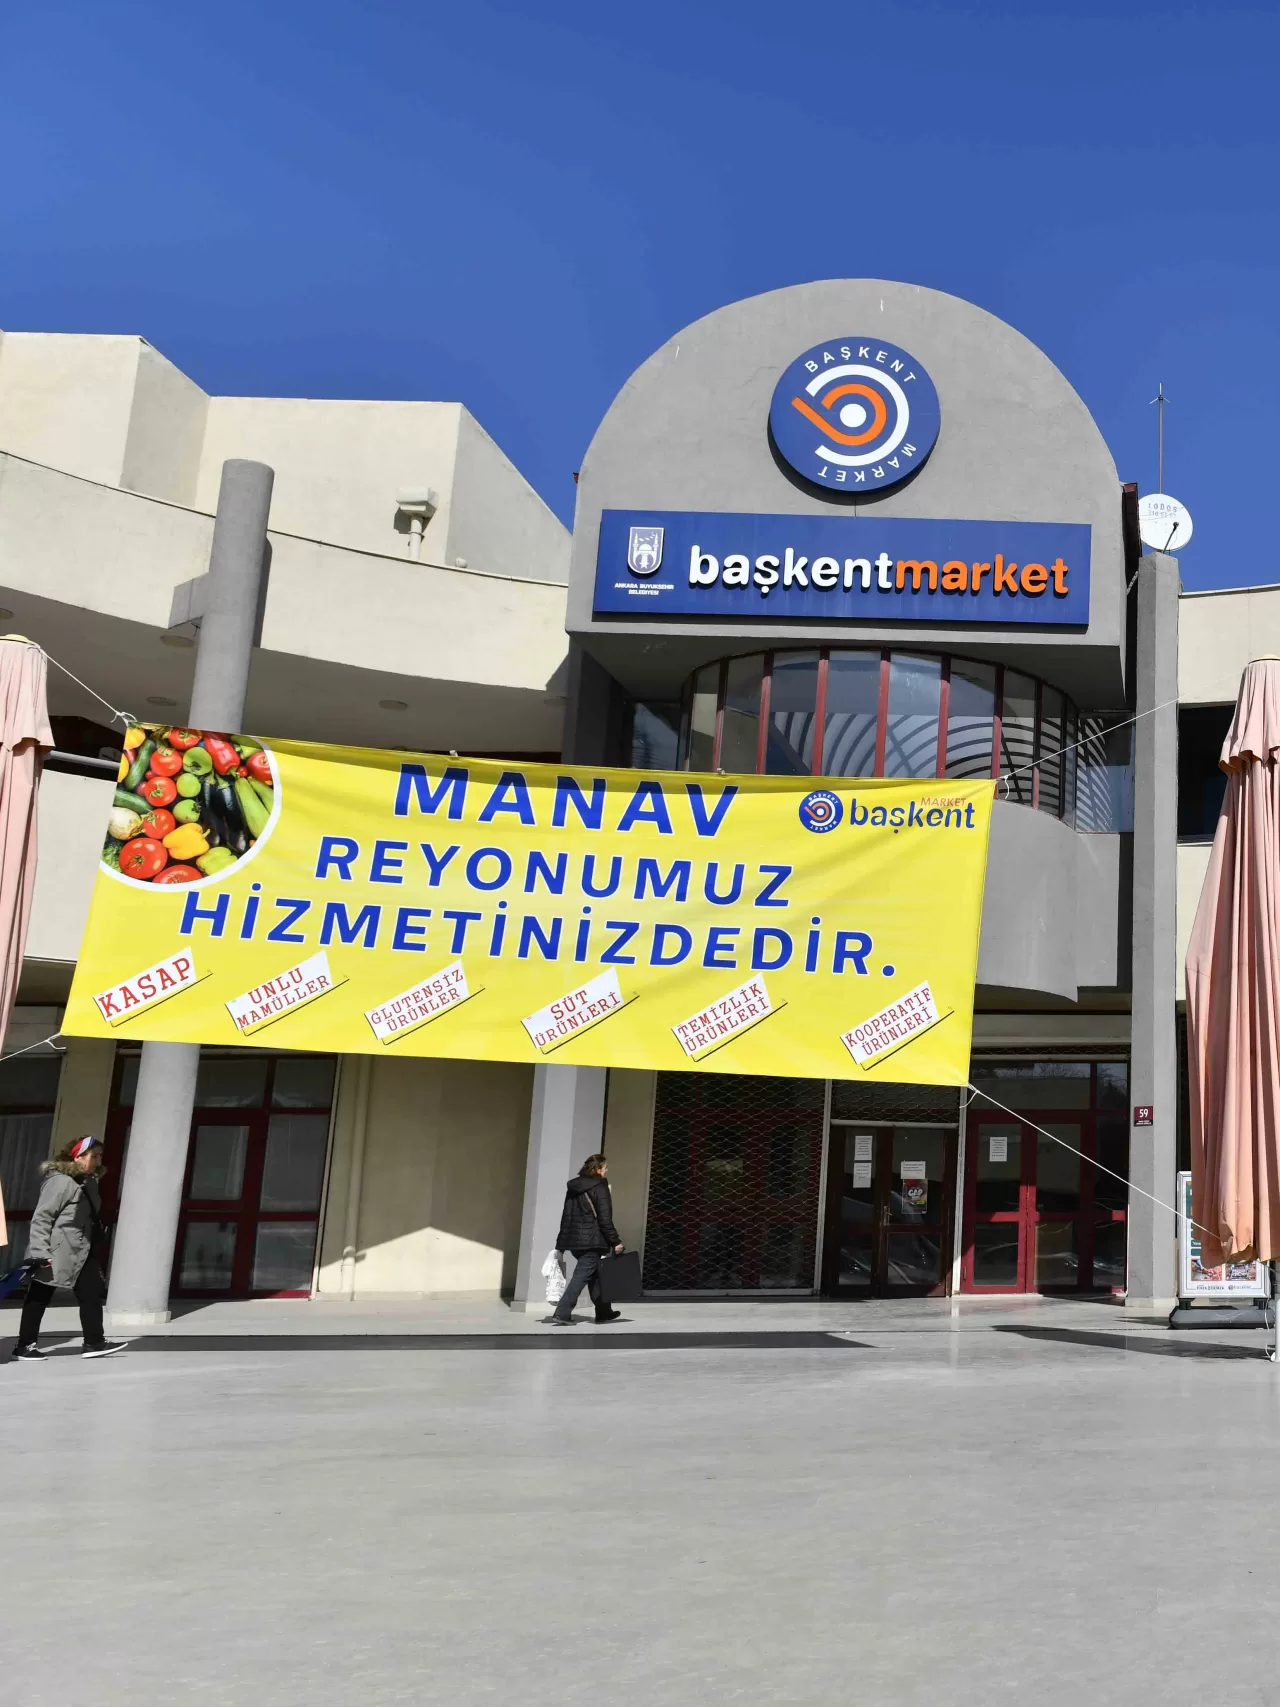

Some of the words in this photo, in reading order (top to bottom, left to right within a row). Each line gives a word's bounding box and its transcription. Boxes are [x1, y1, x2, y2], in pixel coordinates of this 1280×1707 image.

[805, 346, 916, 382] BAŞKENT
[817, 443, 917, 483] MARKET
[393, 763, 739, 838] MANAV
[850, 798, 975, 834] başkent
[920, 797, 967, 808] MARKET
[315, 836, 793, 907] REYONUMUZ
[179, 883, 897, 978] HİZMETİNİZDEDİR.
[99, 956, 192, 1019] KASAP
[237, 974, 331, 1030] MAMÜLLER
[248, 967, 304, 1006] UNLU
[370, 968, 465, 1025] GLUTENSİZ
[386, 987, 461, 1033] ÜRÜNLER
[550, 989, 588, 1021] SÜT
[676, 982, 763, 1039] TEMİZLİK
[533, 991, 621, 1050] ÜRÜNLERİ
[684, 997, 771, 1053] ÜRÜNLERİ
[845, 986, 933, 1049] KOOPERATİF
[860, 1009, 934, 1057] ÜRÜNLERİ
[1139, 1108, 1149, 1118] 59
